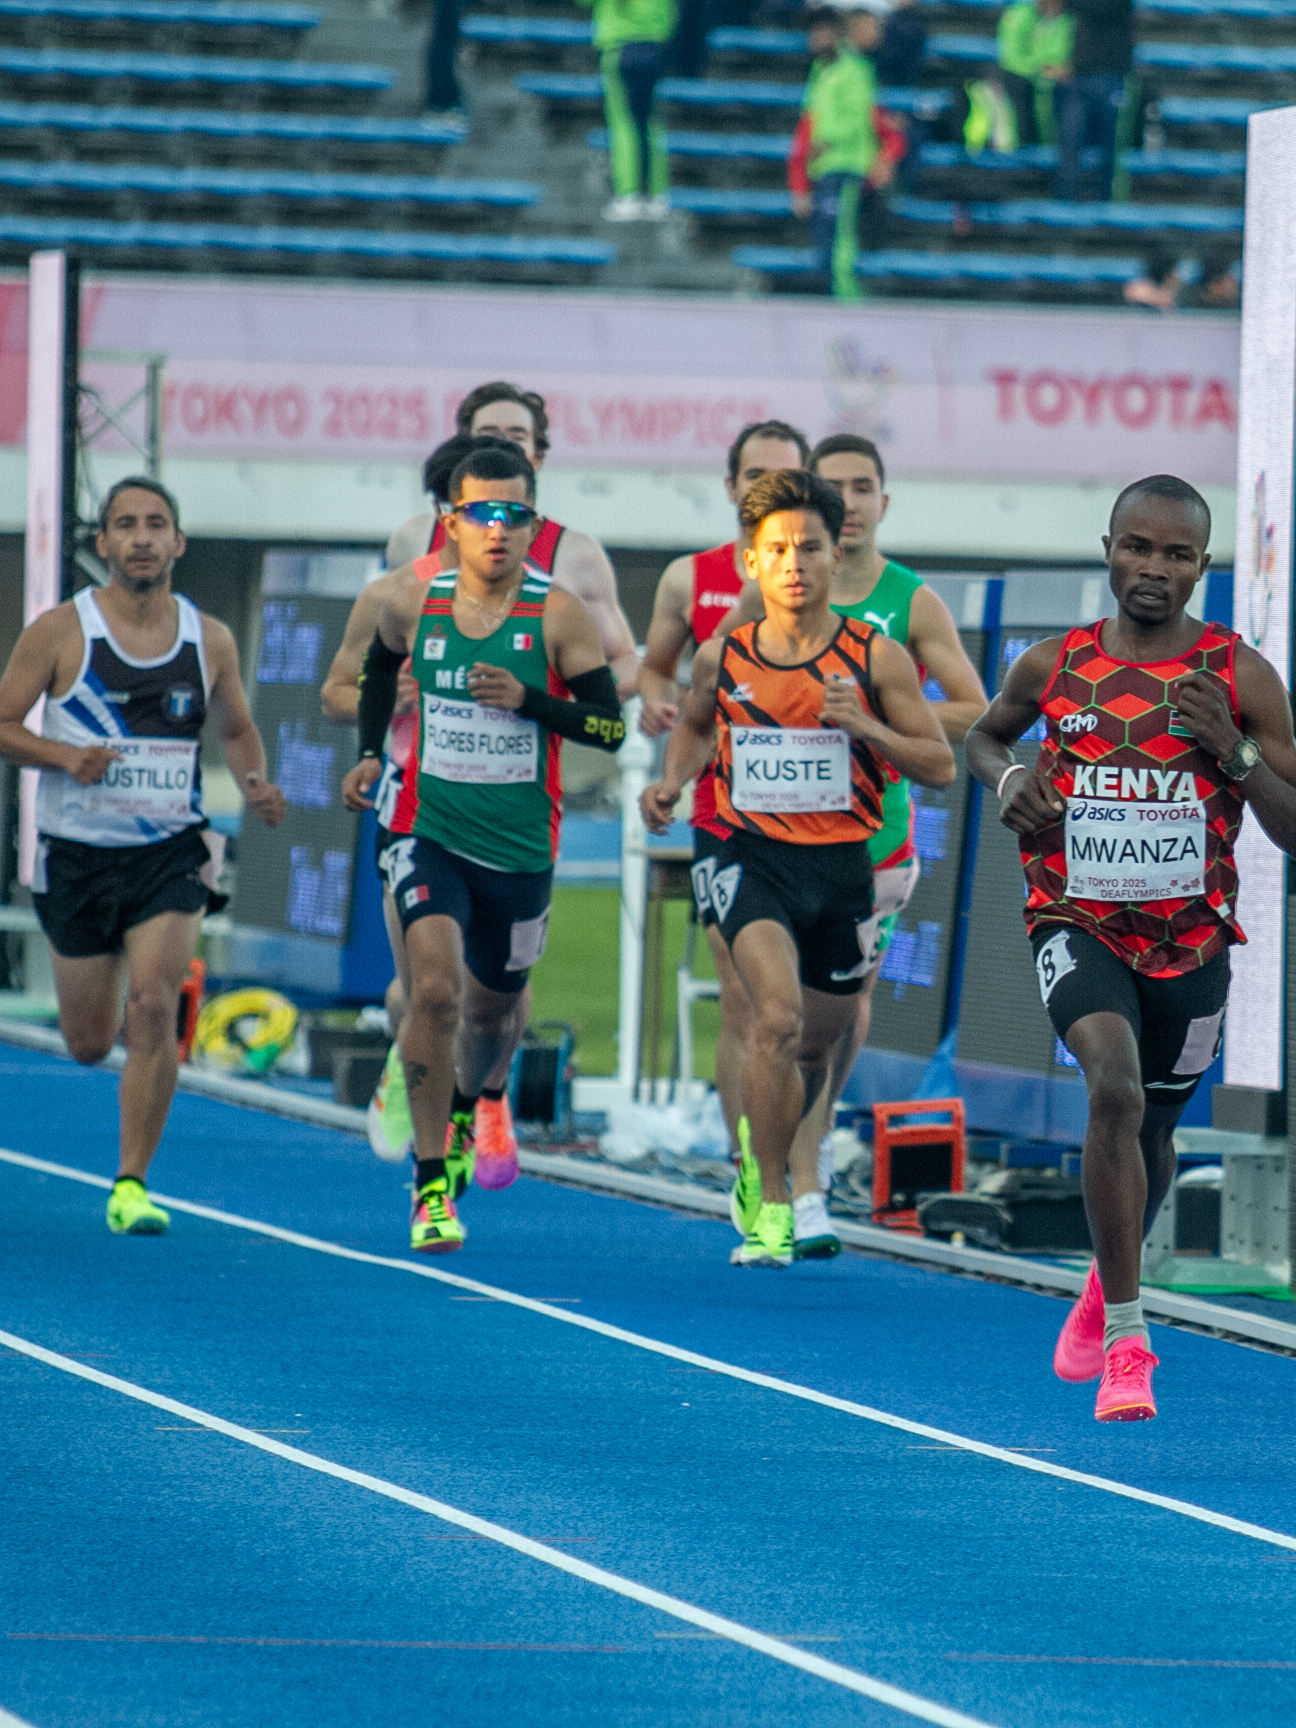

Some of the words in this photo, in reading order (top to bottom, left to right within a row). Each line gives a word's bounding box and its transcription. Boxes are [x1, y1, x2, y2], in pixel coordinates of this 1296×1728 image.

[161, 380, 311, 438] TOKYO
[321, 384, 435, 441] 2025
[984, 367, 1238, 431] TOYOTA
[428, 725, 475, 753] FLORES
[478, 733, 532, 756] FLORES
[749, 733, 782, 746] asics
[791, 735, 844, 746] TOYOTA
[95, 767, 188, 790] USTILLO
[745, 759, 832, 781] KUSTE
[1072, 765, 1199, 802] KENYA
[1087, 807, 1126, 821] asics
[1136, 807, 1200, 821] TOYOTA
[1071, 835, 1200, 863] MWANZA
[1087, 877, 1119, 888] TOKYO
[1122, 879, 1146, 888] 2025
[1101, 887, 1172, 899] DEAFLYMPICS
[1042, 948, 1056, 988] 8
